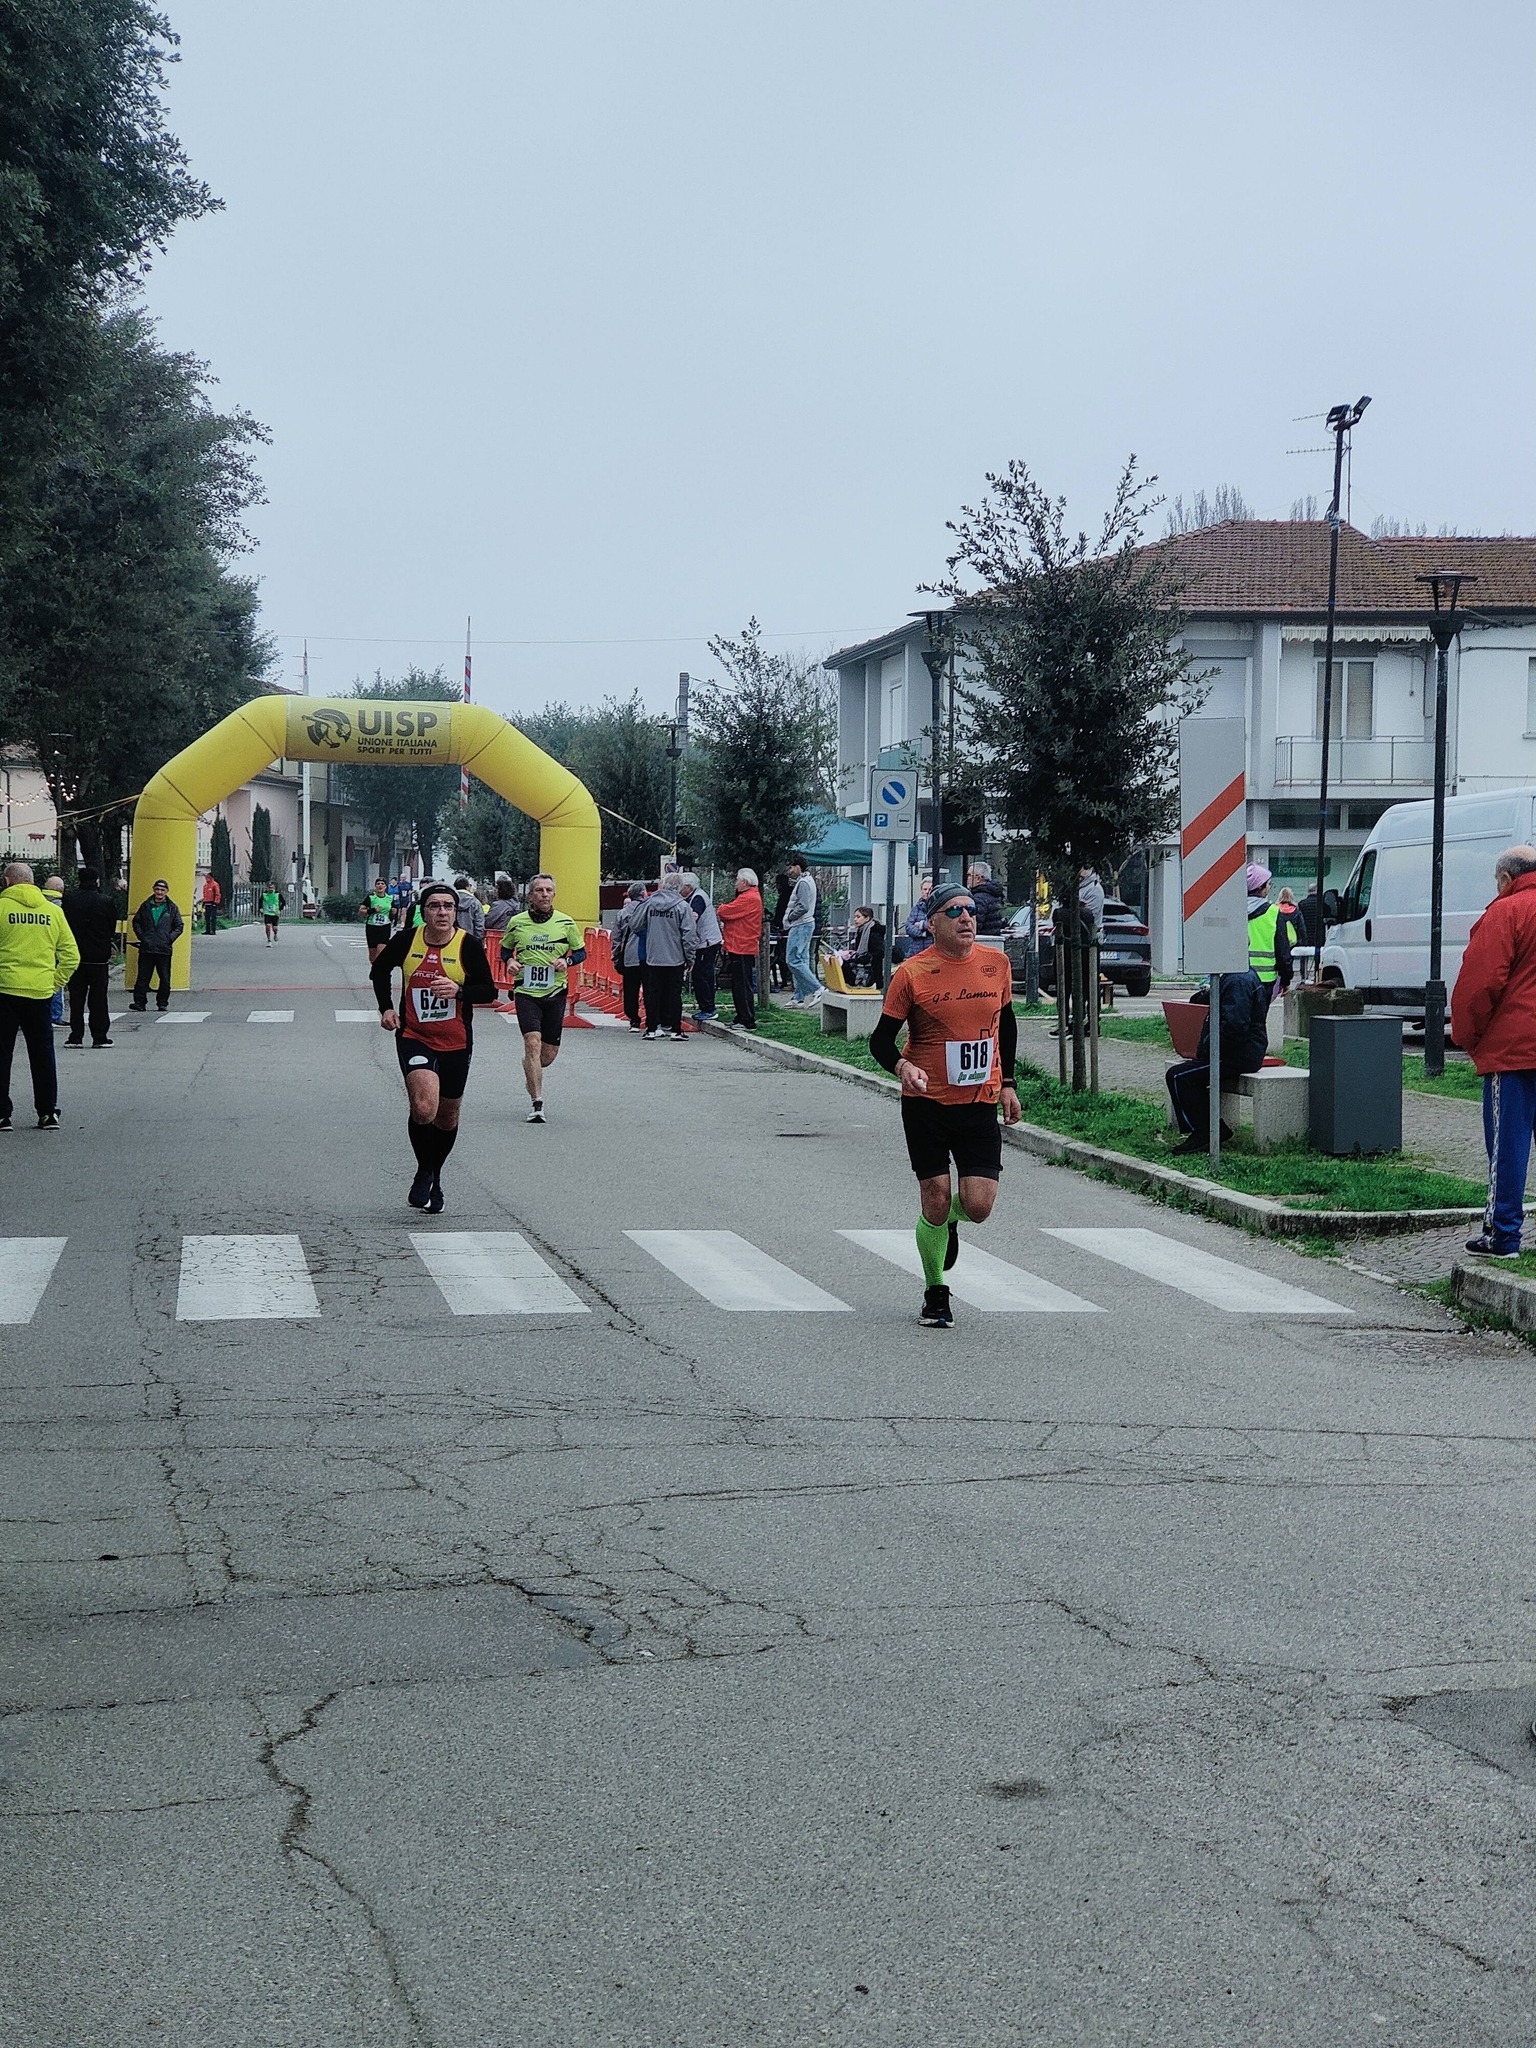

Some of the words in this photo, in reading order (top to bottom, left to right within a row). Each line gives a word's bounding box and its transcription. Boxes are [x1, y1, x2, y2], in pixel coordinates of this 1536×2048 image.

[358, 710, 437, 737] UISP
[358, 738, 393, 746] UNIONE
[397, 739, 437, 747] ITALIANA
[357, 746, 385, 754] SPORT
[389, 747, 405, 755] PER
[877, 815, 886, 825] P
[8, 913, 51, 925] GIUDICE
[531, 966, 549, 982] 681
[956, 988, 998, 1000] Lamone
[960, 1041, 988, 1070] 618
